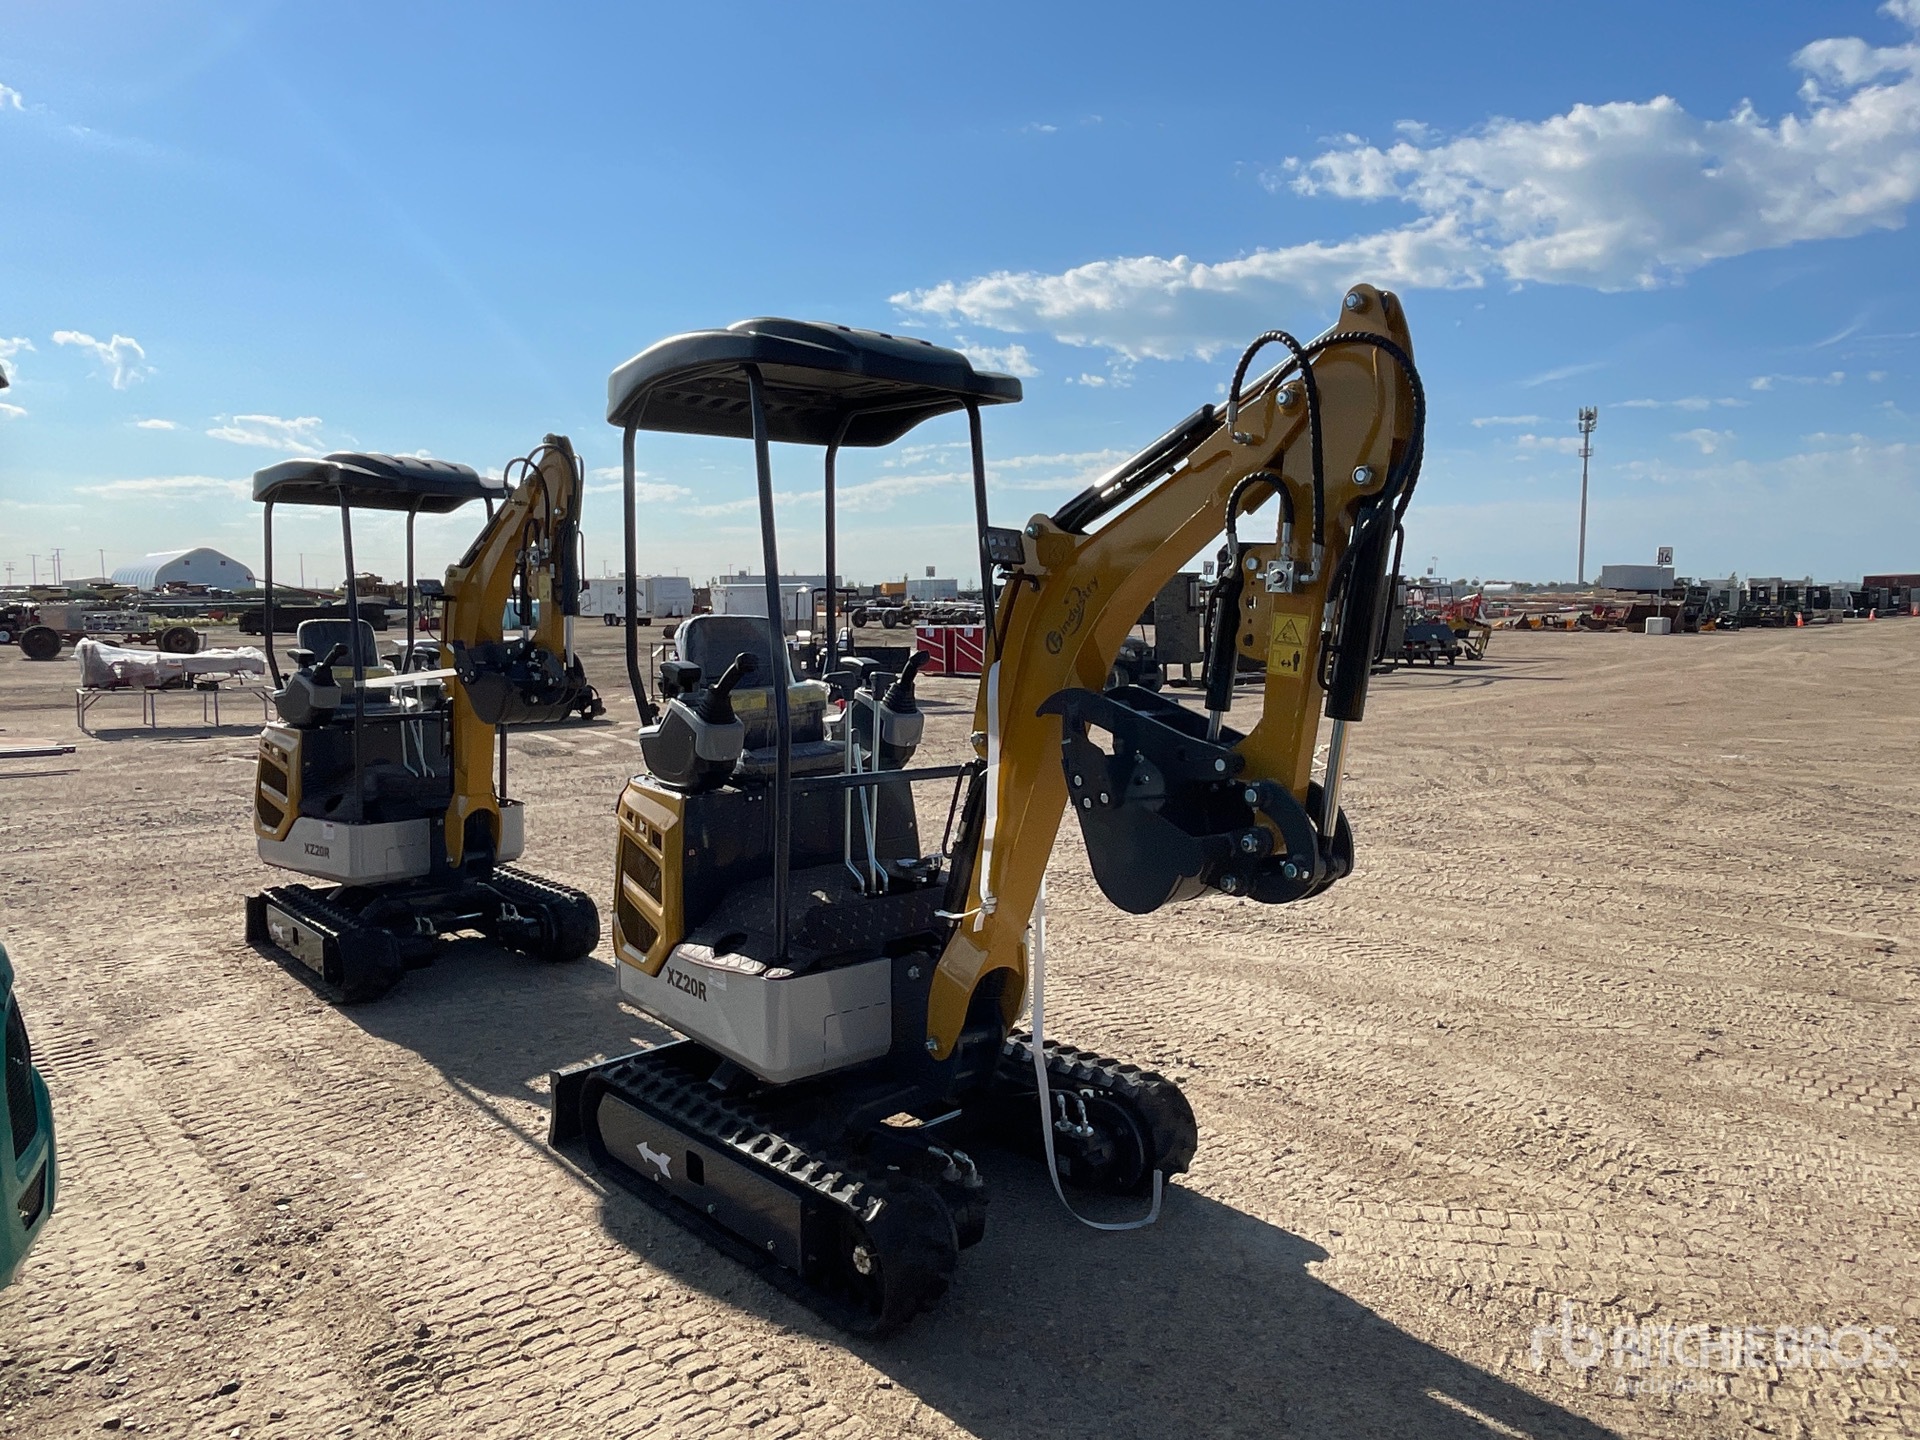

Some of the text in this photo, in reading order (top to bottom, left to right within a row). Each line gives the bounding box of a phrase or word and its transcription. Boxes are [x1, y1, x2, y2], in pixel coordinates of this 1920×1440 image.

[1660, 551, 1671, 563] 16
[304, 842, 330, 860] XZ20R
[666, 966, 707, 1002] XZ20R
